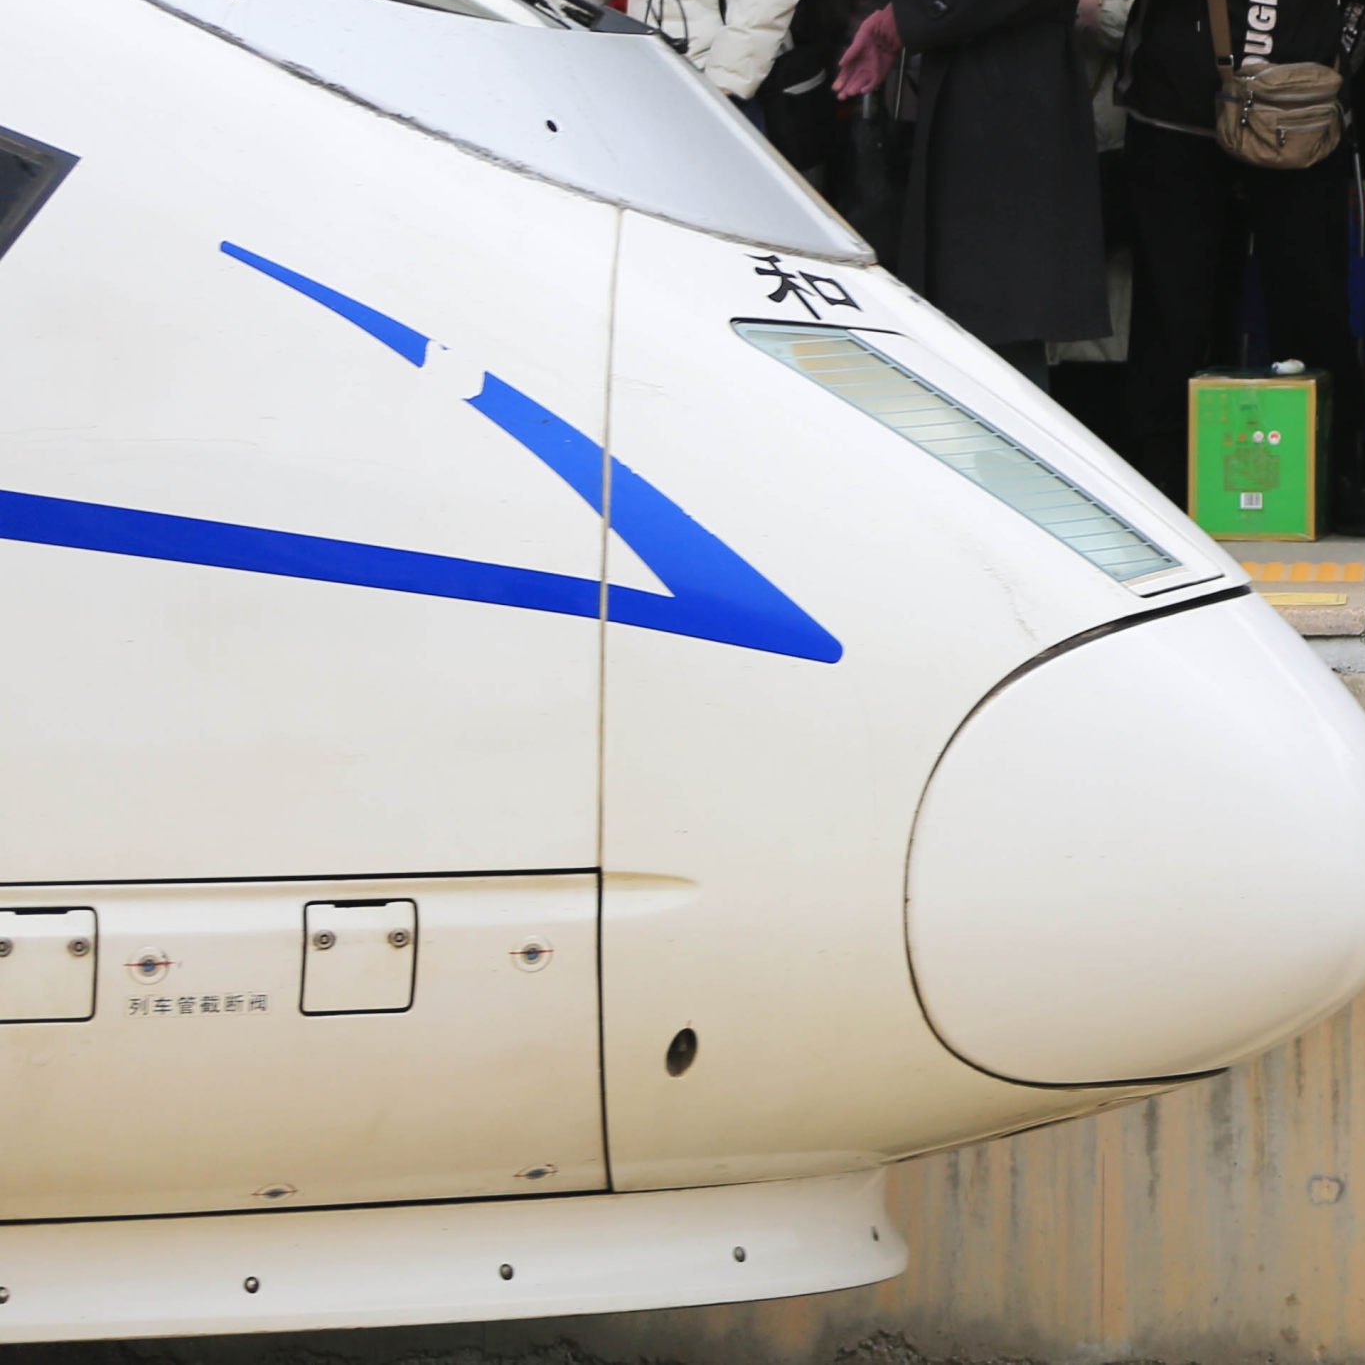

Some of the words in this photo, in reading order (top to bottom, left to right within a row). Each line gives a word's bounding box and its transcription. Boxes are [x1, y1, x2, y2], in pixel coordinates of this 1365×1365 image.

[744, 254, 862, 320] 和
[128, 994, 268, 1016] 列车管截断阀
